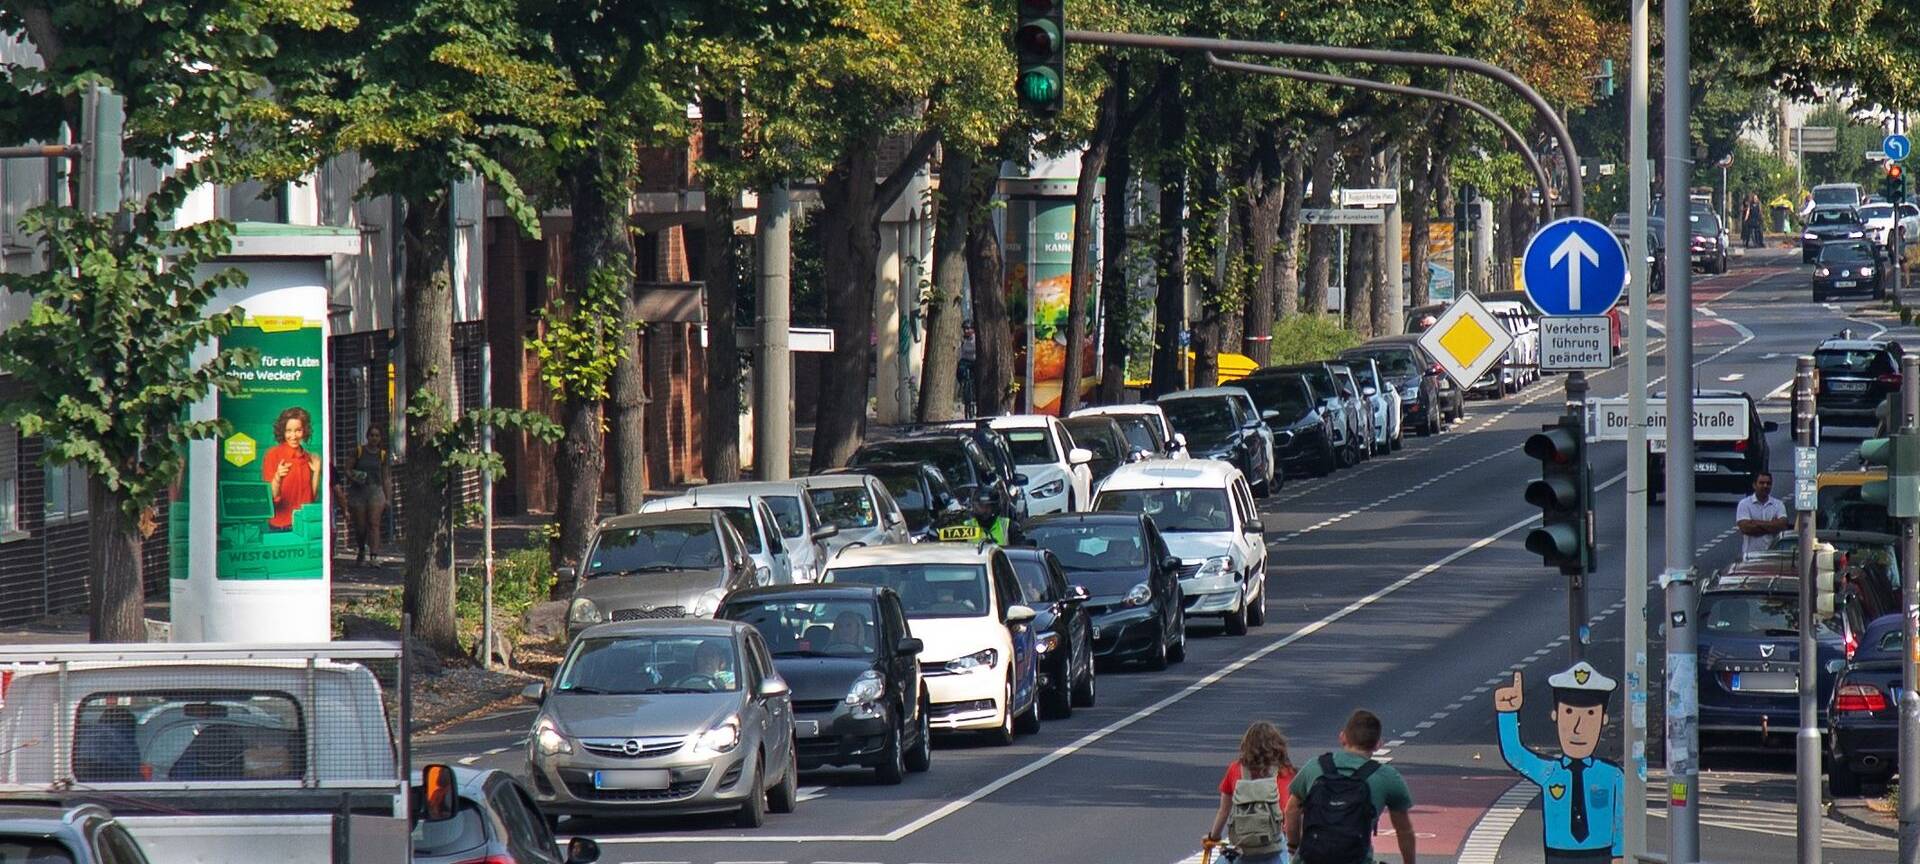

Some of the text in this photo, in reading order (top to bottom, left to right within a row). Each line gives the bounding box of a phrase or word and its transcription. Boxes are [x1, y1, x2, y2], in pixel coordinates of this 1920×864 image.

[1054, 231, 1068, 241] SO
[1545, 323, 1606, 334] Verkehrs-
[1552, 337, 1599, 351] führung
[261, 355, 278, 367] für
[280, 356, 295, 367] ein
[297, 356, 320, 367] Leben
[1549, 351, 1602, 365] geändert
[256, 370, 301, 381] Wecker?
[1607, 411, 1734, 428] Boreim Straße
[947, 529, 974, 538] TAXI
[230, 548, 304, 562] WEST LOTTO
